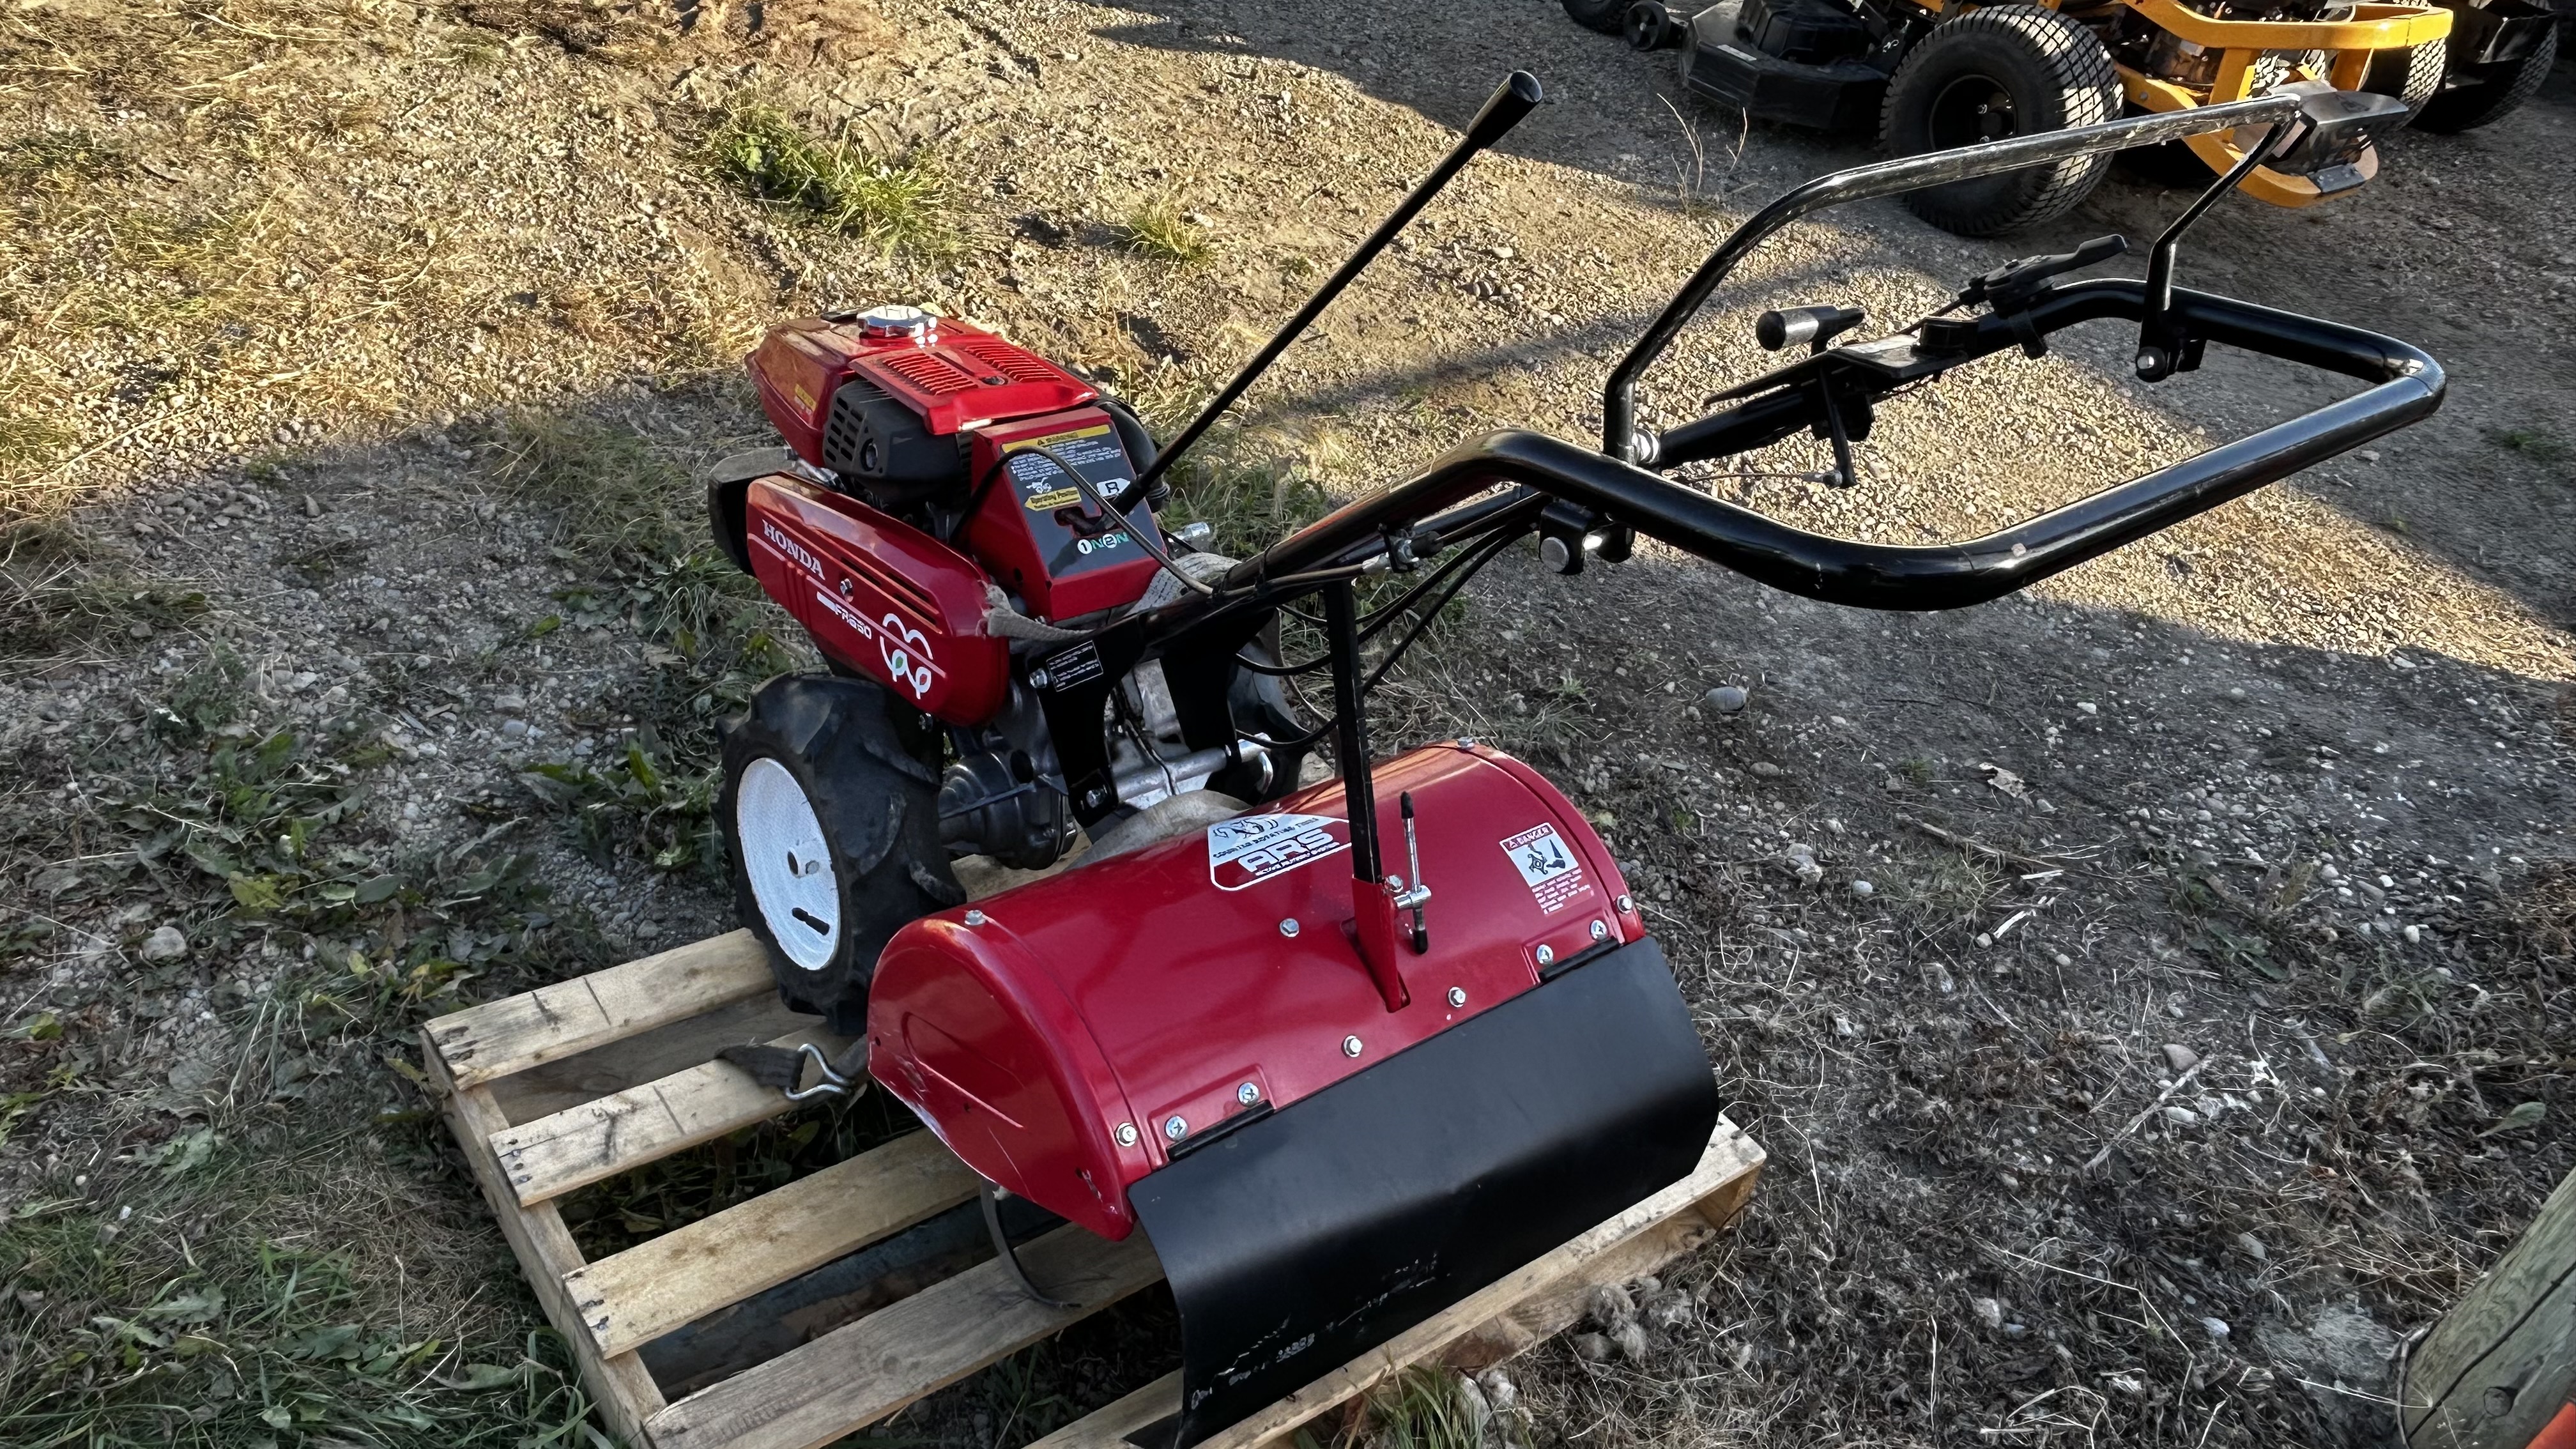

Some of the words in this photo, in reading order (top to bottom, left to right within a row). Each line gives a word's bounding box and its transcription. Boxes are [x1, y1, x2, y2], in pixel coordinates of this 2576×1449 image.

[762, 518, 825, 581] HONDA
[1091, 538, 1105, 549] N
[1116, 531, 1130, 544] N
[1238, 828, 1334, 873] ARS
[1517, 827, 1549, 845] DANGER
